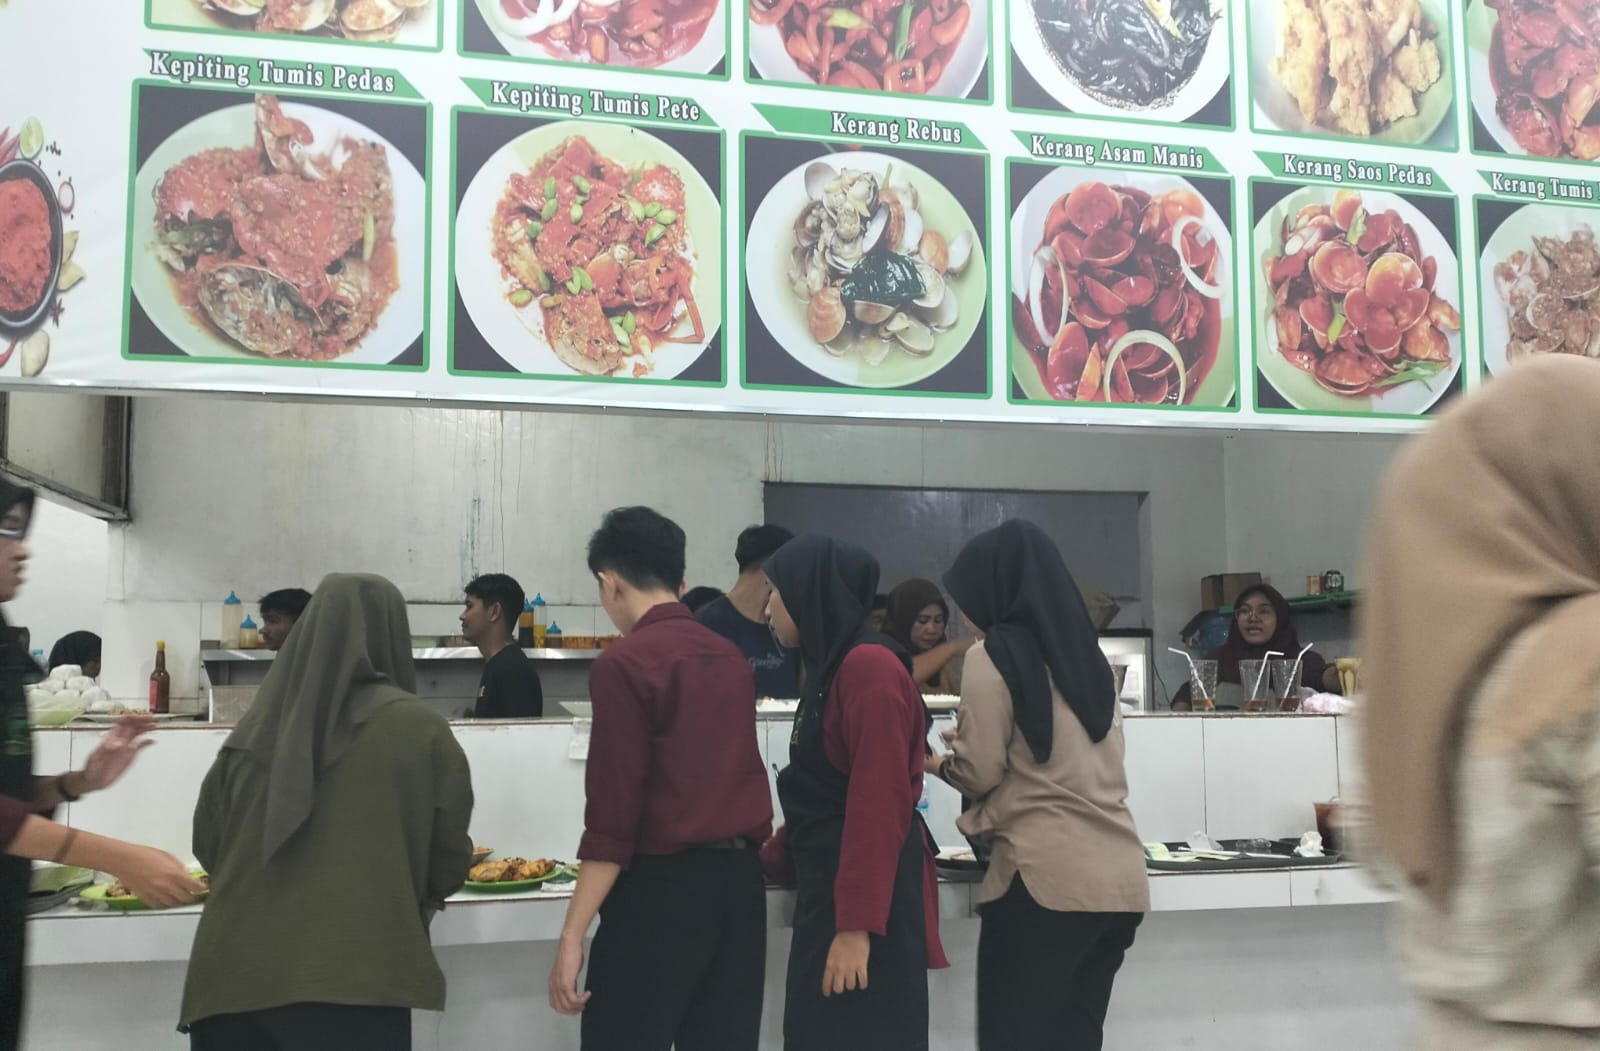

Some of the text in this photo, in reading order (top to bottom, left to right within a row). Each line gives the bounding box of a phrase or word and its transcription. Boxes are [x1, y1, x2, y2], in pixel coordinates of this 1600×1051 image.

[150, 52, 394, 92] Kepiting Tumis Pedas
[491, 81, 699, 120] Kepiting Tumis Pete
[831, 111, 961, 143] Kerang Rebus
[1031, 134, 1203, 168] Kerang Asam Manis
[1283, 153, 1432, 186] Kerang Saos Pedas
[1490, 172, 1546, 200] Kerang
[1549, 177, 1593, 199] Tumis
